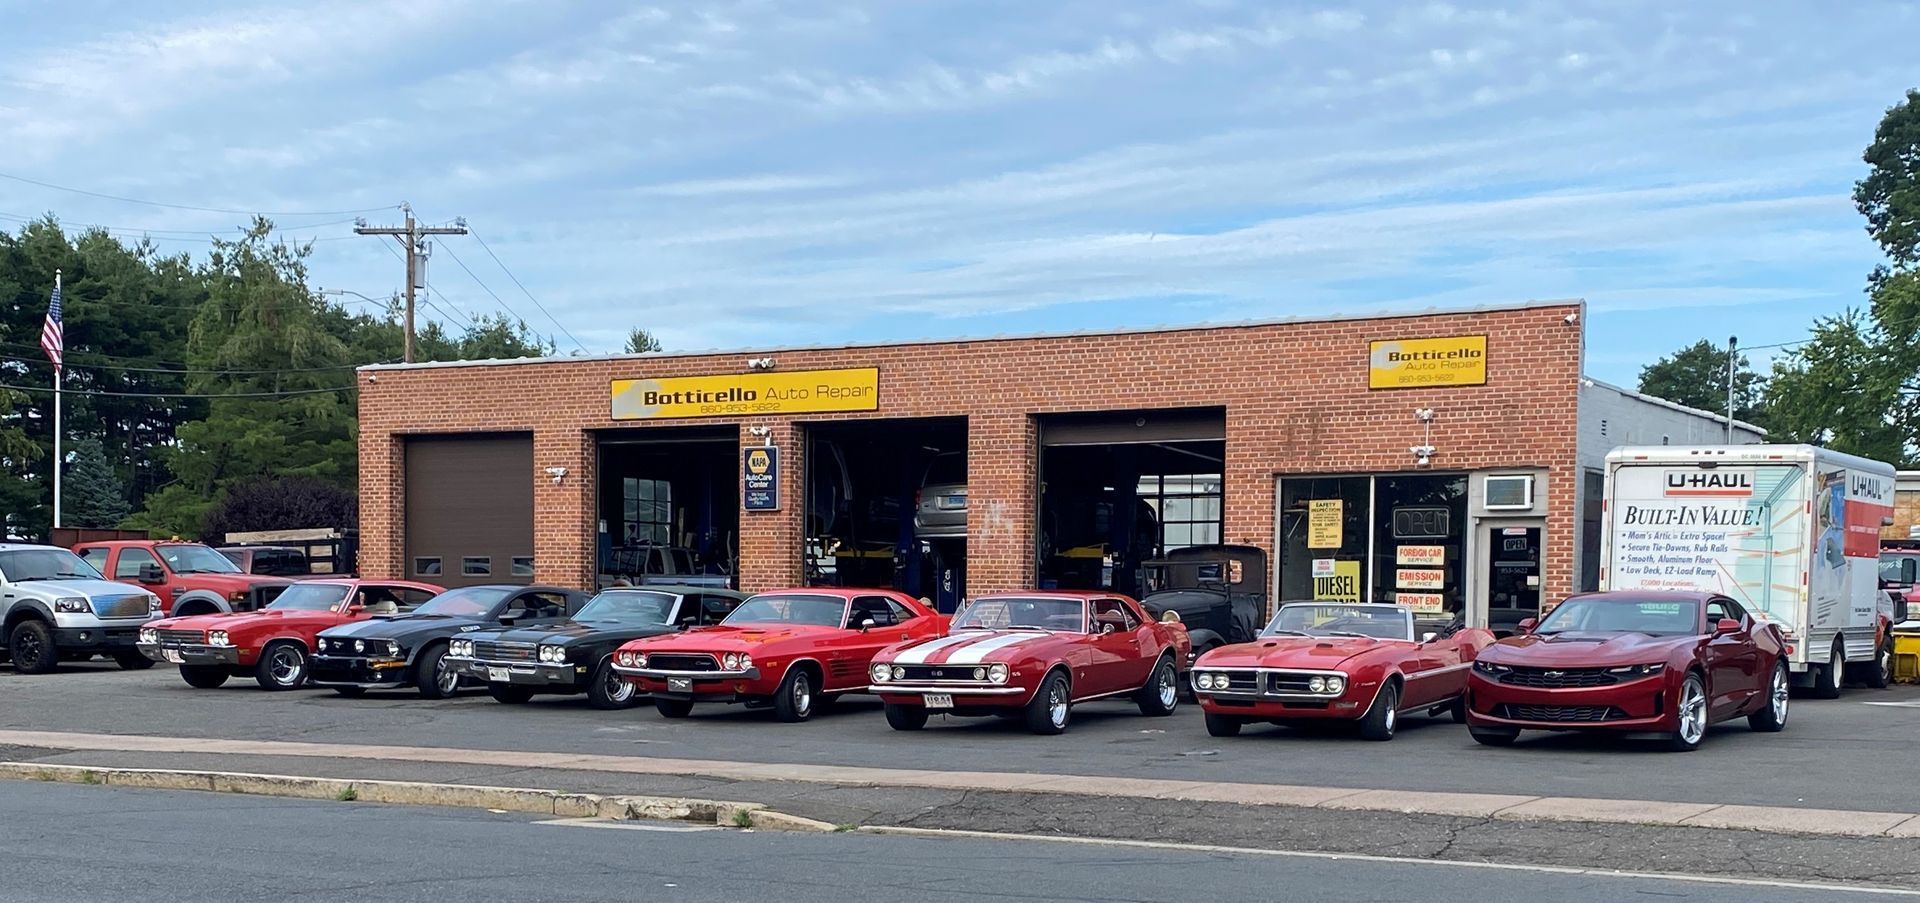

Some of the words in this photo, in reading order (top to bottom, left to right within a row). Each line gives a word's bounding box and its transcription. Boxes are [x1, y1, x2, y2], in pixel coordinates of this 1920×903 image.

[1389, 348, 1481, 361] Botticello
[1405, 362, 1436, 371] Auto
[1441, 360, 1481, 369] Repair
[644, 387, 757, 406] Botticello
[765, 387, 809, 400] Auto
[816, 384, 874, 399] Repair
[701, 403, 781, 413] 860-953-5622
[752, 457, 766, 467] NAPA
[1668, 473, 1751, 487] U-HAUL
[1397, 511, 1446, 534] OPEN
[1627, 531, 1652, 540] Mom's
[1653, 531, 1671, 540] Attic
[1680, 531, 1700, 540] Extra
[1505, 540, 1526, 549] OPEN
[1627, 543, 1651, 551] Secure
[1652, 543, 1692, 553] Tie-Downs,
[1694, 544, 1708, 552] Rub
[1710, 544, 1728, 553] Rails
[1400, 549, 1427, 557] FOREIGN
[1429, 549, 1442, 557] CAR
[1626, 554, 1655, 563] Smooth,
[1657, 555, 1693, 564] Aluminum
[1694, 555, 1714, 564] Floor
[1399, 572, 1441, 581] EMISSION
[1626, 566, 1642, 574] Low
[1643, 567, 1663, 576] Deck,
[1664, 566, 1694, 575] EZ-Load
[1695, 568, 1717, 577] Ramp
[1317, 576, 1357, 596] DIESEL
[1398, 596, 1424, 605] FRONT
[1425, 597, 1441, 606] END
